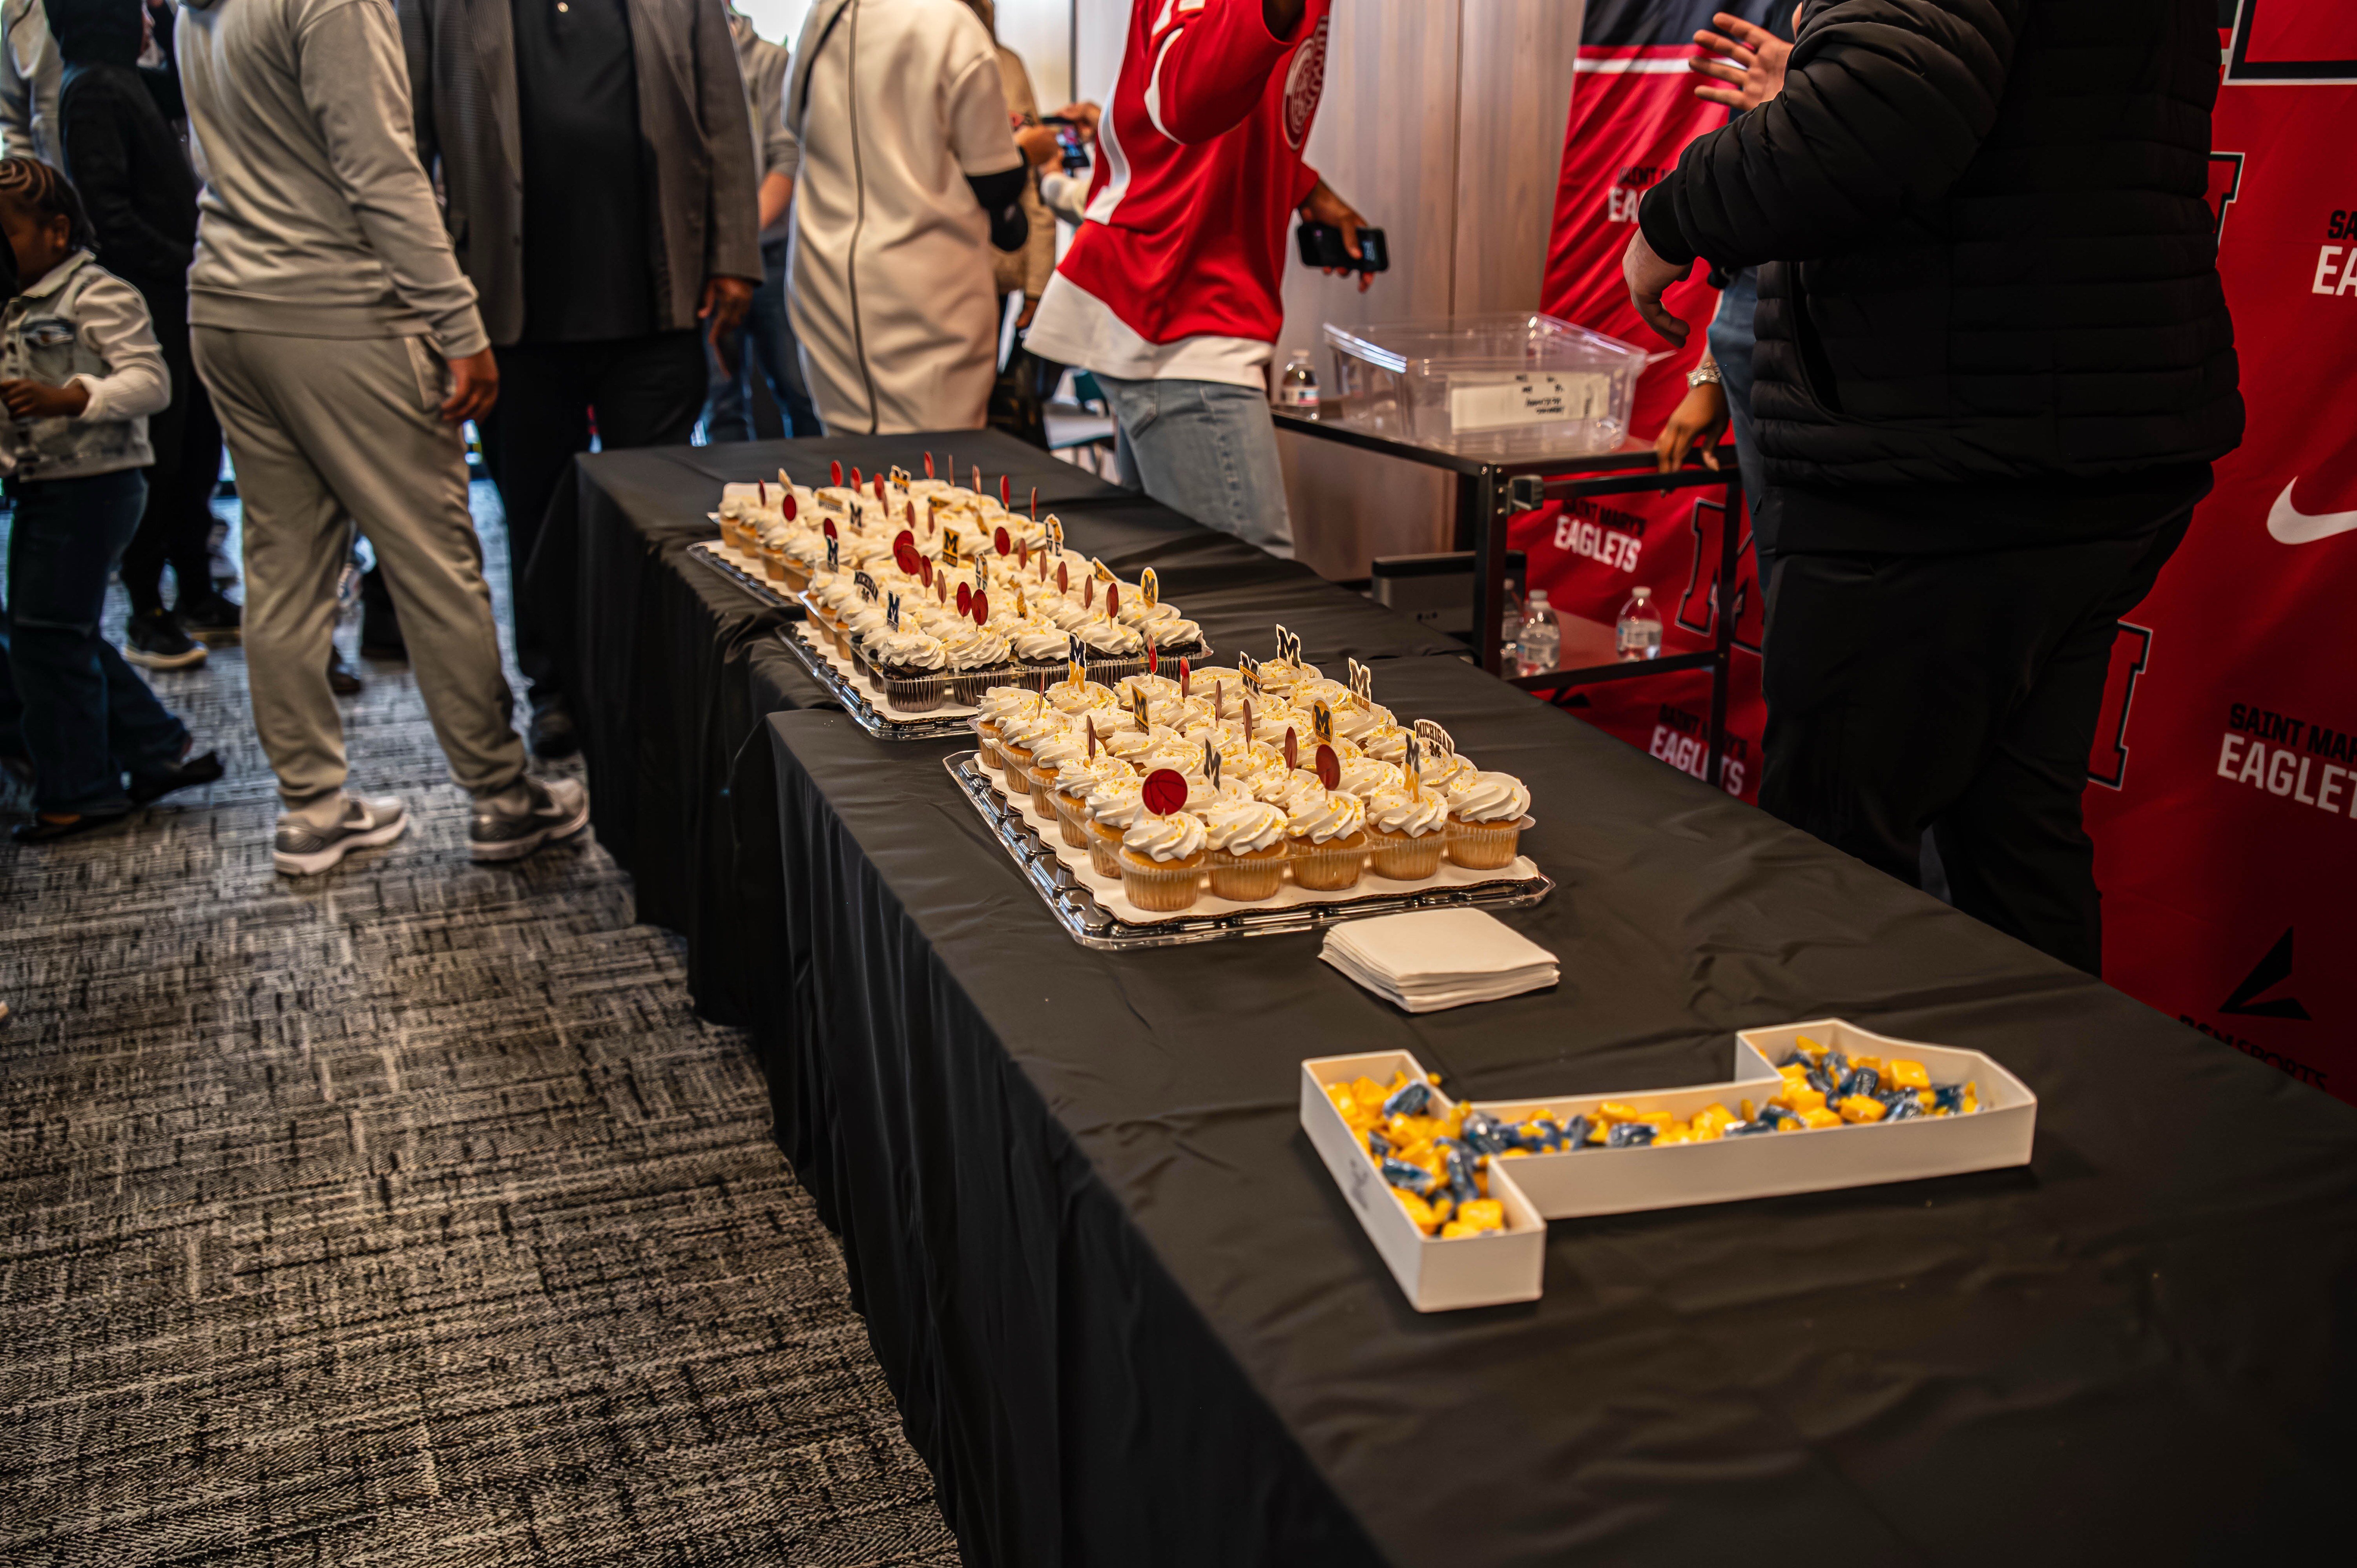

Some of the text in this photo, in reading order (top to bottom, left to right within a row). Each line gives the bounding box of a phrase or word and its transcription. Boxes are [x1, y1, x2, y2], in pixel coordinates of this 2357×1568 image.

[944, 530, 958, 554] M
[1554, 515, 1642, 573] EAGLETS
[1144, 574, 1155, 598] M
[887, 592, 900, 625] M
[1278, 628, 1300, 669] M
[1350, 662, 1369, 700] M
[1133, 688, 1147, 724] M
[1314, 705, 1330, 737] M
[1415, 721, 1452, 758] MICHIGAN
[2229, 702, 2305, 748] SAINT
[1203, 738, 1221, 792] M
